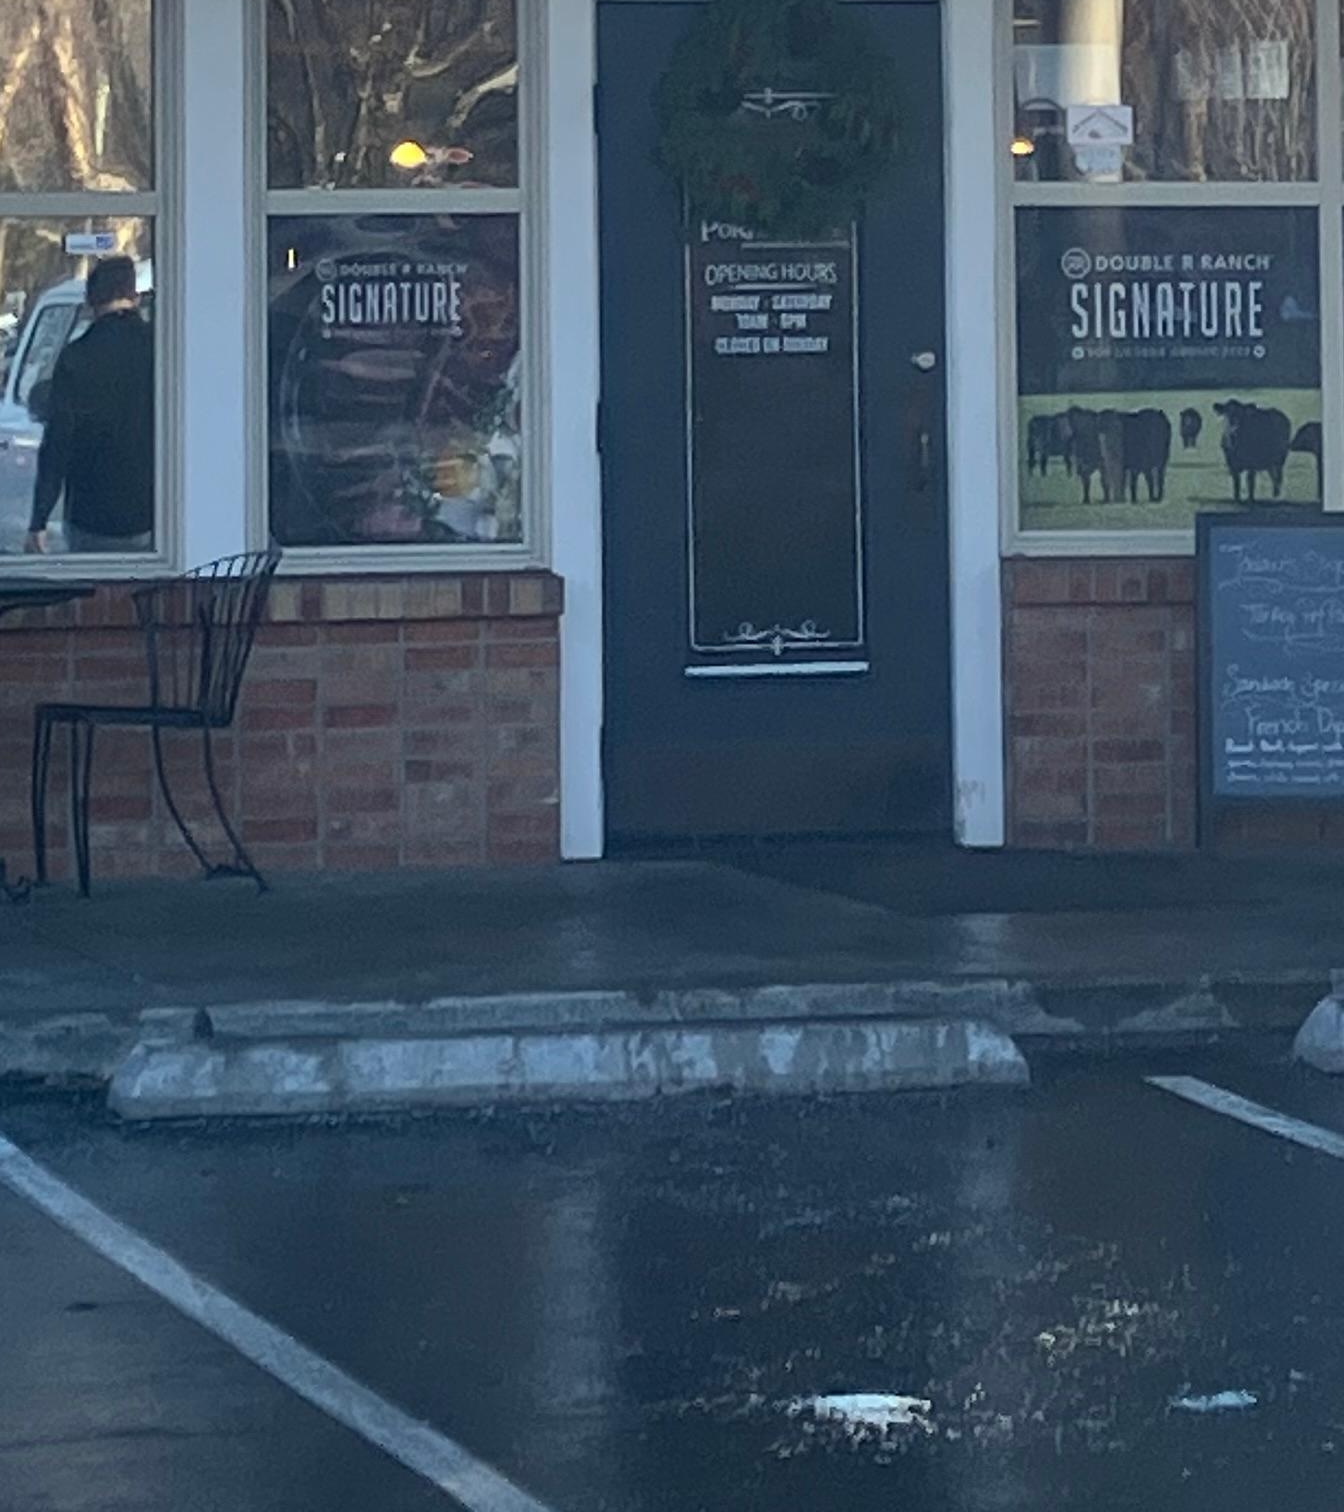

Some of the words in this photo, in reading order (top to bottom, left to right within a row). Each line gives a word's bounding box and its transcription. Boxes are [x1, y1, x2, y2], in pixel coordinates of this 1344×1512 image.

[704, 262, 777, 286] OPENING
[781, 261, 837, 284] HOURS
[1094, 254, 1174, 272] DOUBLE
[1200, 253, 1271, 271] RANCH
[320, 280, 462, 325] SIGNATURE
[1070, 281, 1264, 339] SIGNATURE
